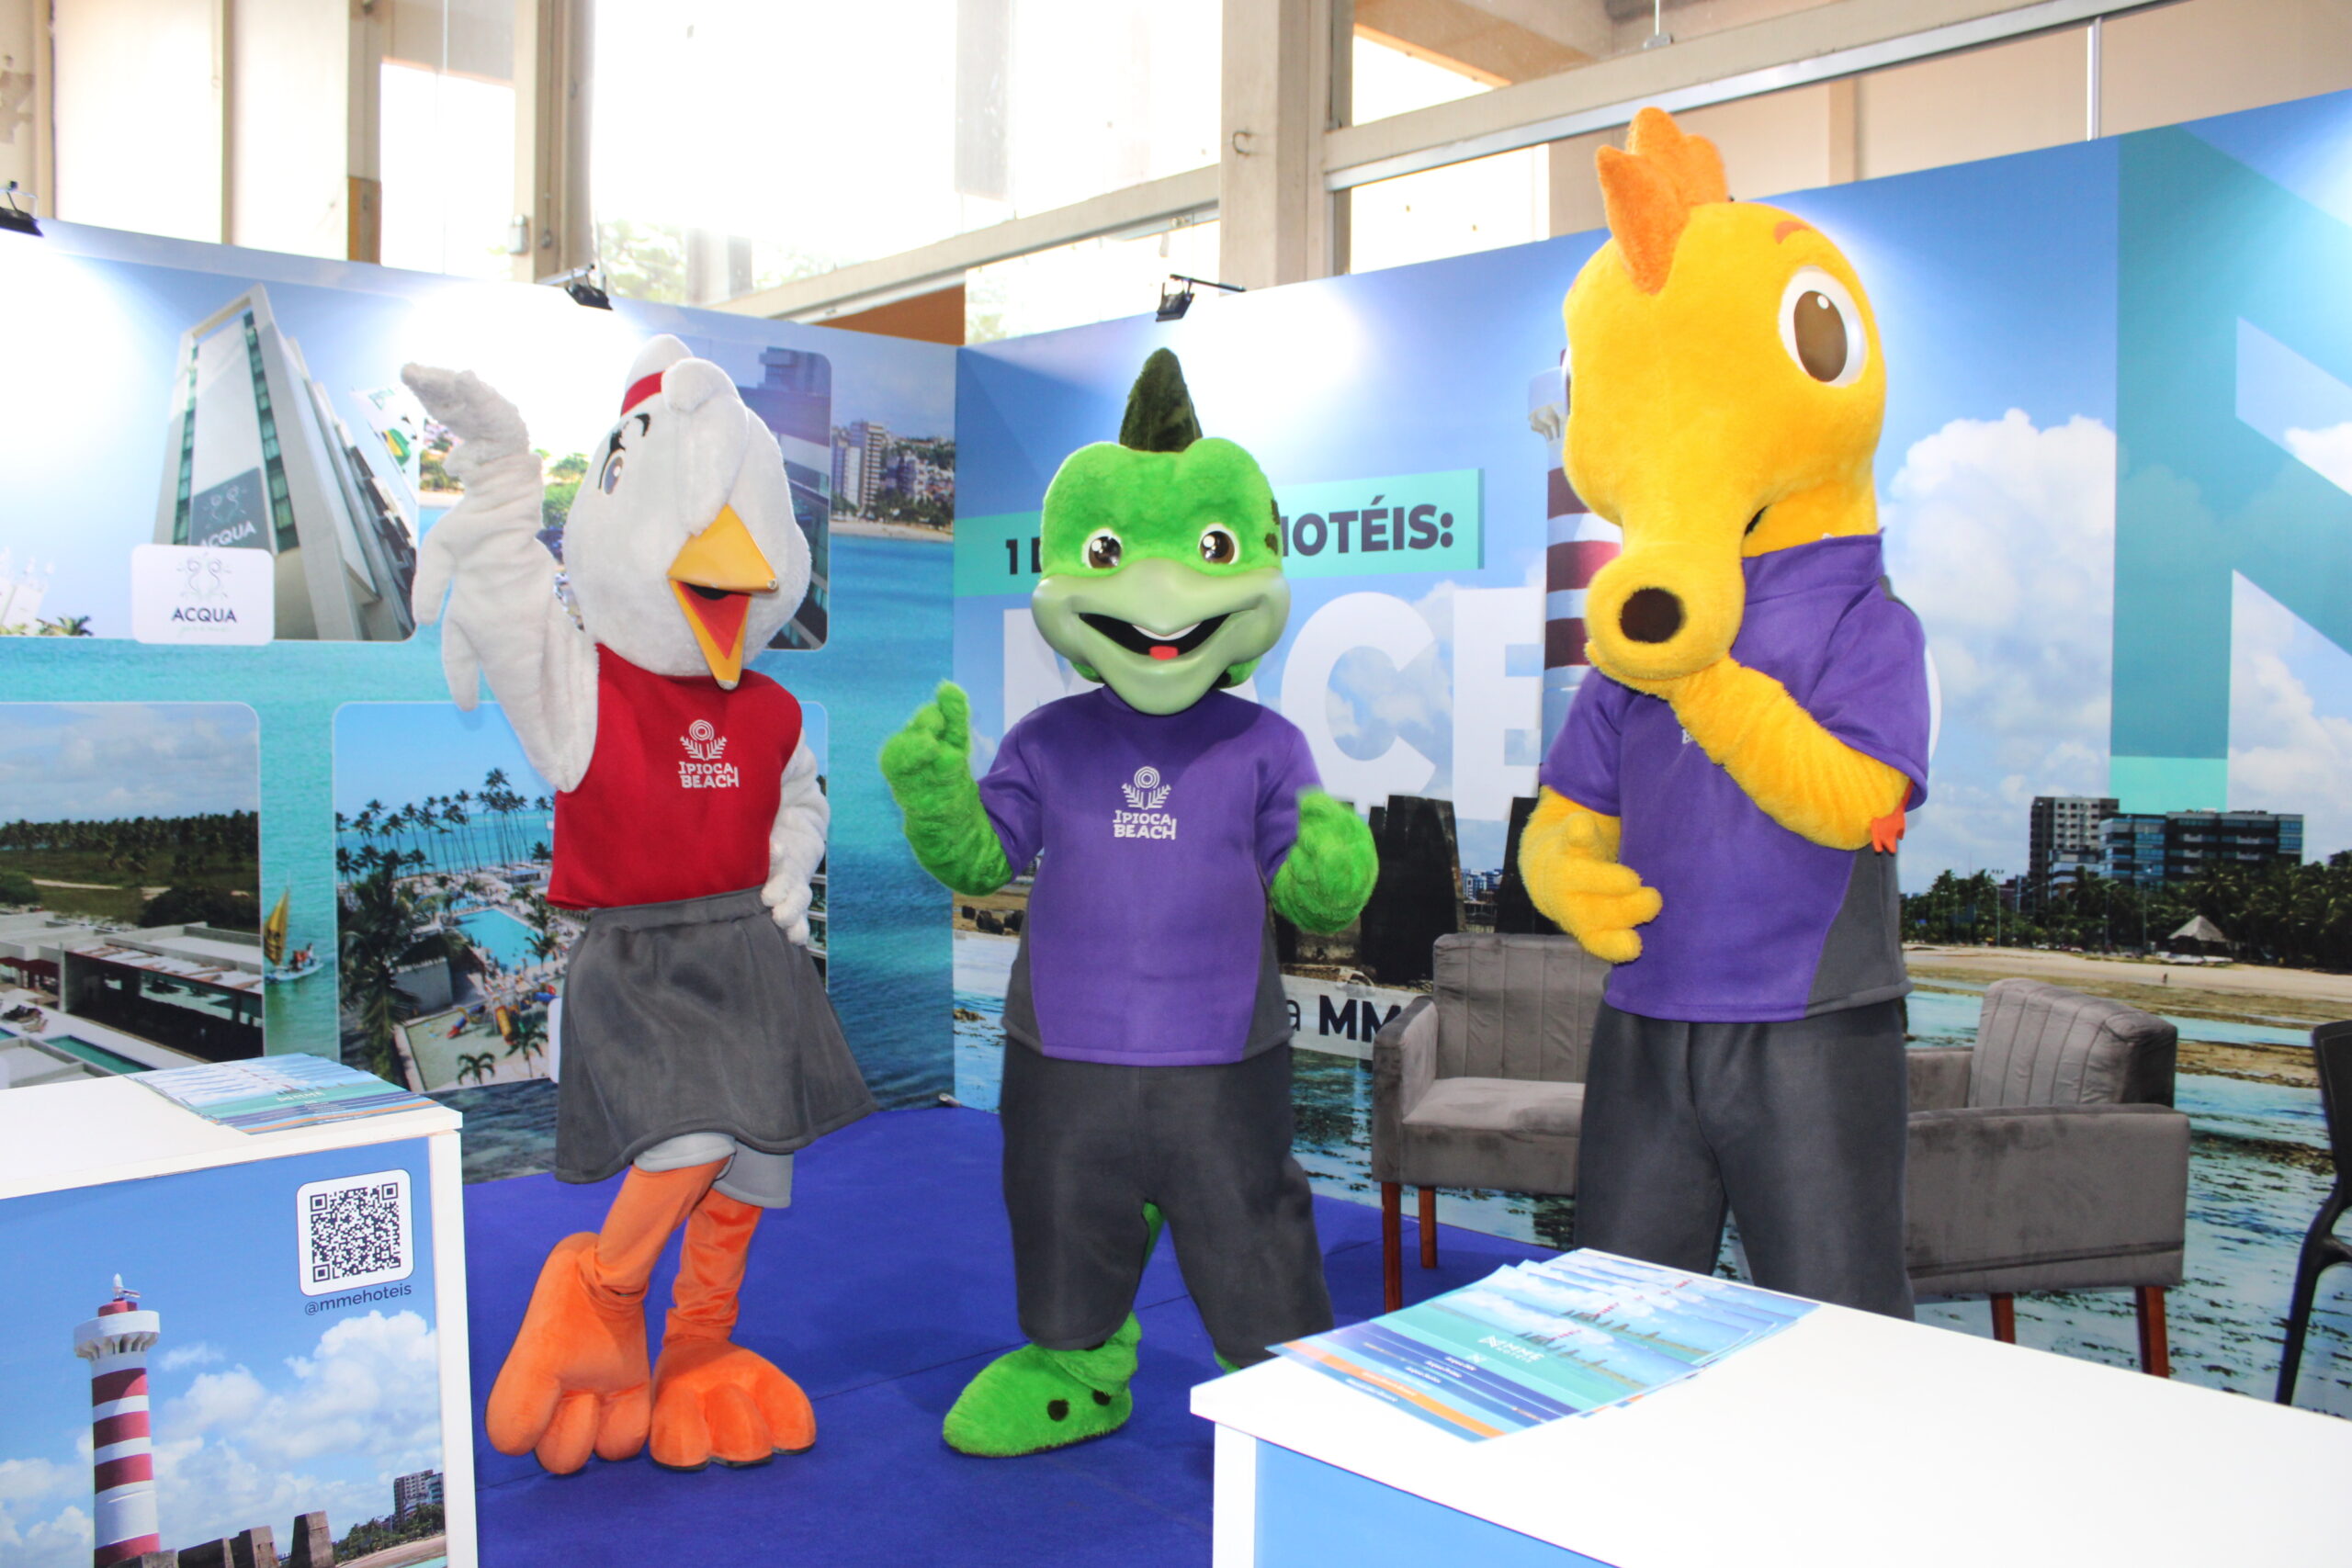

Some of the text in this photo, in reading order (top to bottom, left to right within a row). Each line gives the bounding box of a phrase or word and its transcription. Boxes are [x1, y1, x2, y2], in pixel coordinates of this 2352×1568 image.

[1005, 538, 1018, 575] 1
[1280, 494, 1453, 558] OTÉIS:
[171, 606, 237, 623] ACQUA
[678, 761, 734, 774] IPIOCA
[680, 766, 740, 788] BEACH
[1113, 809, 1171, 826] IPIOCA
[1114, 818, 1177, 840] BEACH
[304, 1282, 413, 1316] @mmehoteis
